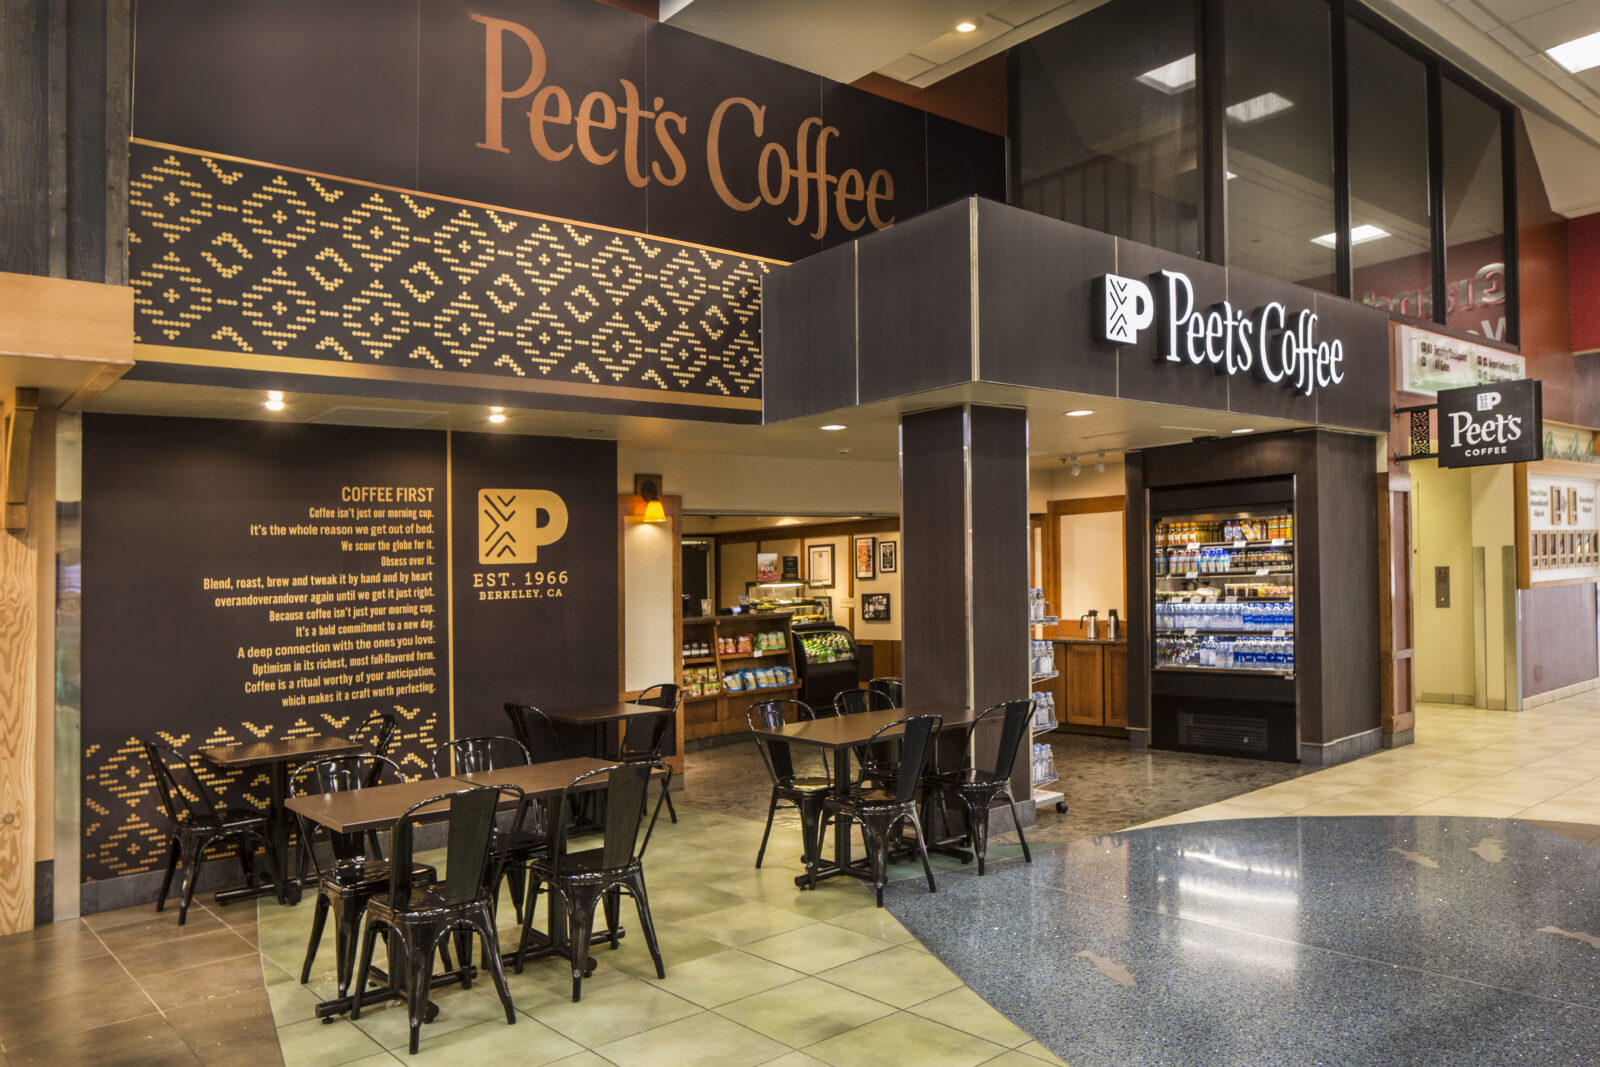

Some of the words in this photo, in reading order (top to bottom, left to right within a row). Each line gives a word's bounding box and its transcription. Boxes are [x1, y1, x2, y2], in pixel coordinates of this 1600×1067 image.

[467, 10, 687, 188] Peet's
[706, 97, 895, 239] Coffee
[1162, 269, 1252, 375] Peet's
[1260, 302, 1344, 396] Coffee
[1447, 411, 1522, 448] Peet's
[1465, 446, 1508, 458] COFFEE
[342, 487, 393, 502] COFFEE
[396, 487, 435, 502] FIRST
[309, 507, 335, 518] Coffee
[338, 508, 355, 518] isn't
[356, 508, 371, 520] just
[373, 509, 386, 518] our
[388, 507, 417, 520] morning
[419, 509, 434, 520] cup.
[250, 524, 267, 536] It's
[269, 524, 286, 535] the
[289, 524, 318, 535] whole
[320, 526, 353, 535] reason
[355, 526, 369, 534] we
[371, 524, 387, 536] get
[388, 524, 403, 534] out
[405, 523, 415, 534] of
[416, 523, 434, 534] bed.
[341, 541, 353, 551] We
[355, 542, 376, 551] scour
[378, 540, 390, 550] the
[393, 540, 412, 552] globe
[414, 539, 425, 549] for
[426, 539, 434, 549] it.
[381, 556, 407, 567] Obsess
[409, 557, 425, 566] over
[426, 555, 434, 565] it.
[203, 577, 233, 590] Blend,
[236, 577, 264, 589] roast,
[267, 576, 290, 587] brew
[292, 575, 308, 586] and
[310, 574, 337, 586] tweak
[340, 574, 346, 584] it
[348, 573, 358, 586] by
[361, 572, 381, 584] hand
[383, 572, 398, 583] and
[400, 572, 409, 584] by
[411, 571, 432, 582] heart
[472, 572, 516, 588] EST.
[524, 571, 569, 586] 1966
[215, 593, 308, 607] overandoverandover
[310, 591, 334, 605] again
[337, 590, 355, 601] until
[358, 591, 370, 600] we
[372, 589, 386, 602] get
[388, 588, 394, 598] it
[396, 588, 412, 600] just
[414, 587, 435, 599] right.
[479, 589, 543, 600] BERKELEY,
[547, 588, 563, 597] CA
[269, 610, 304, 622] Because
[306, 608, 331, 620] coffee
[334, 607, 351, 618] isn't
[353, 606, 368, 619] just
[370, 607, 387, 618] your
[388, 604, 418, 615] morning
[420, 604, 435, 614] cup.
[296, 626, 309, 637] It's
[312, 628, 316, 636] a
[319, 624, 336, 635] bold
[338, 621, 385, 634] commitment
[387, 621, 395, 631] to
[397, 622, 402, 630] a
[404, 621, 418, 629] new
[421, 619, 435, 630] day.
[238, 647, 245, 658] A
[247, 646, 272, 659] deep
[275, 642, 330, 656] connection
[332, 640, 353, 651] with
[356, 639, 371, 650] the
[374, 639, 395, 648] ones
[397, 637, 413, 649] you
[415, 635, 435, 645] love.
[253, 662, 291, 677] Optimism
[294, 661, 301, 671] in
[304, 660, 314, 670] its
[317, 657, 347, 669] richest,
[350, 656, 369, 666] most
[371, 651, 414, 664] full-flavored
[416, 651, 435, 660] form.
[245, 680, 276, 693] Coffee
[278, 679, 286, 690] is
[289, 680, 294, 689] a
[297, 676, 320, 688] ritual
[323, 674, 353, 686] worthy
[356, 672, 364, 682] of
[366, 672, 384, 684] your
[387, 666, 435, 679] anticipation,
[282, 694, 306, 706] which
[308, 693, 334, 704] makes
[336, 691, 342, 701] it
[345, 692, 349, 700] a
[352, 688, 370, 699] craft
[372, 685, 394, 697] worth
[396, 682, 435, 696] perfecting.
